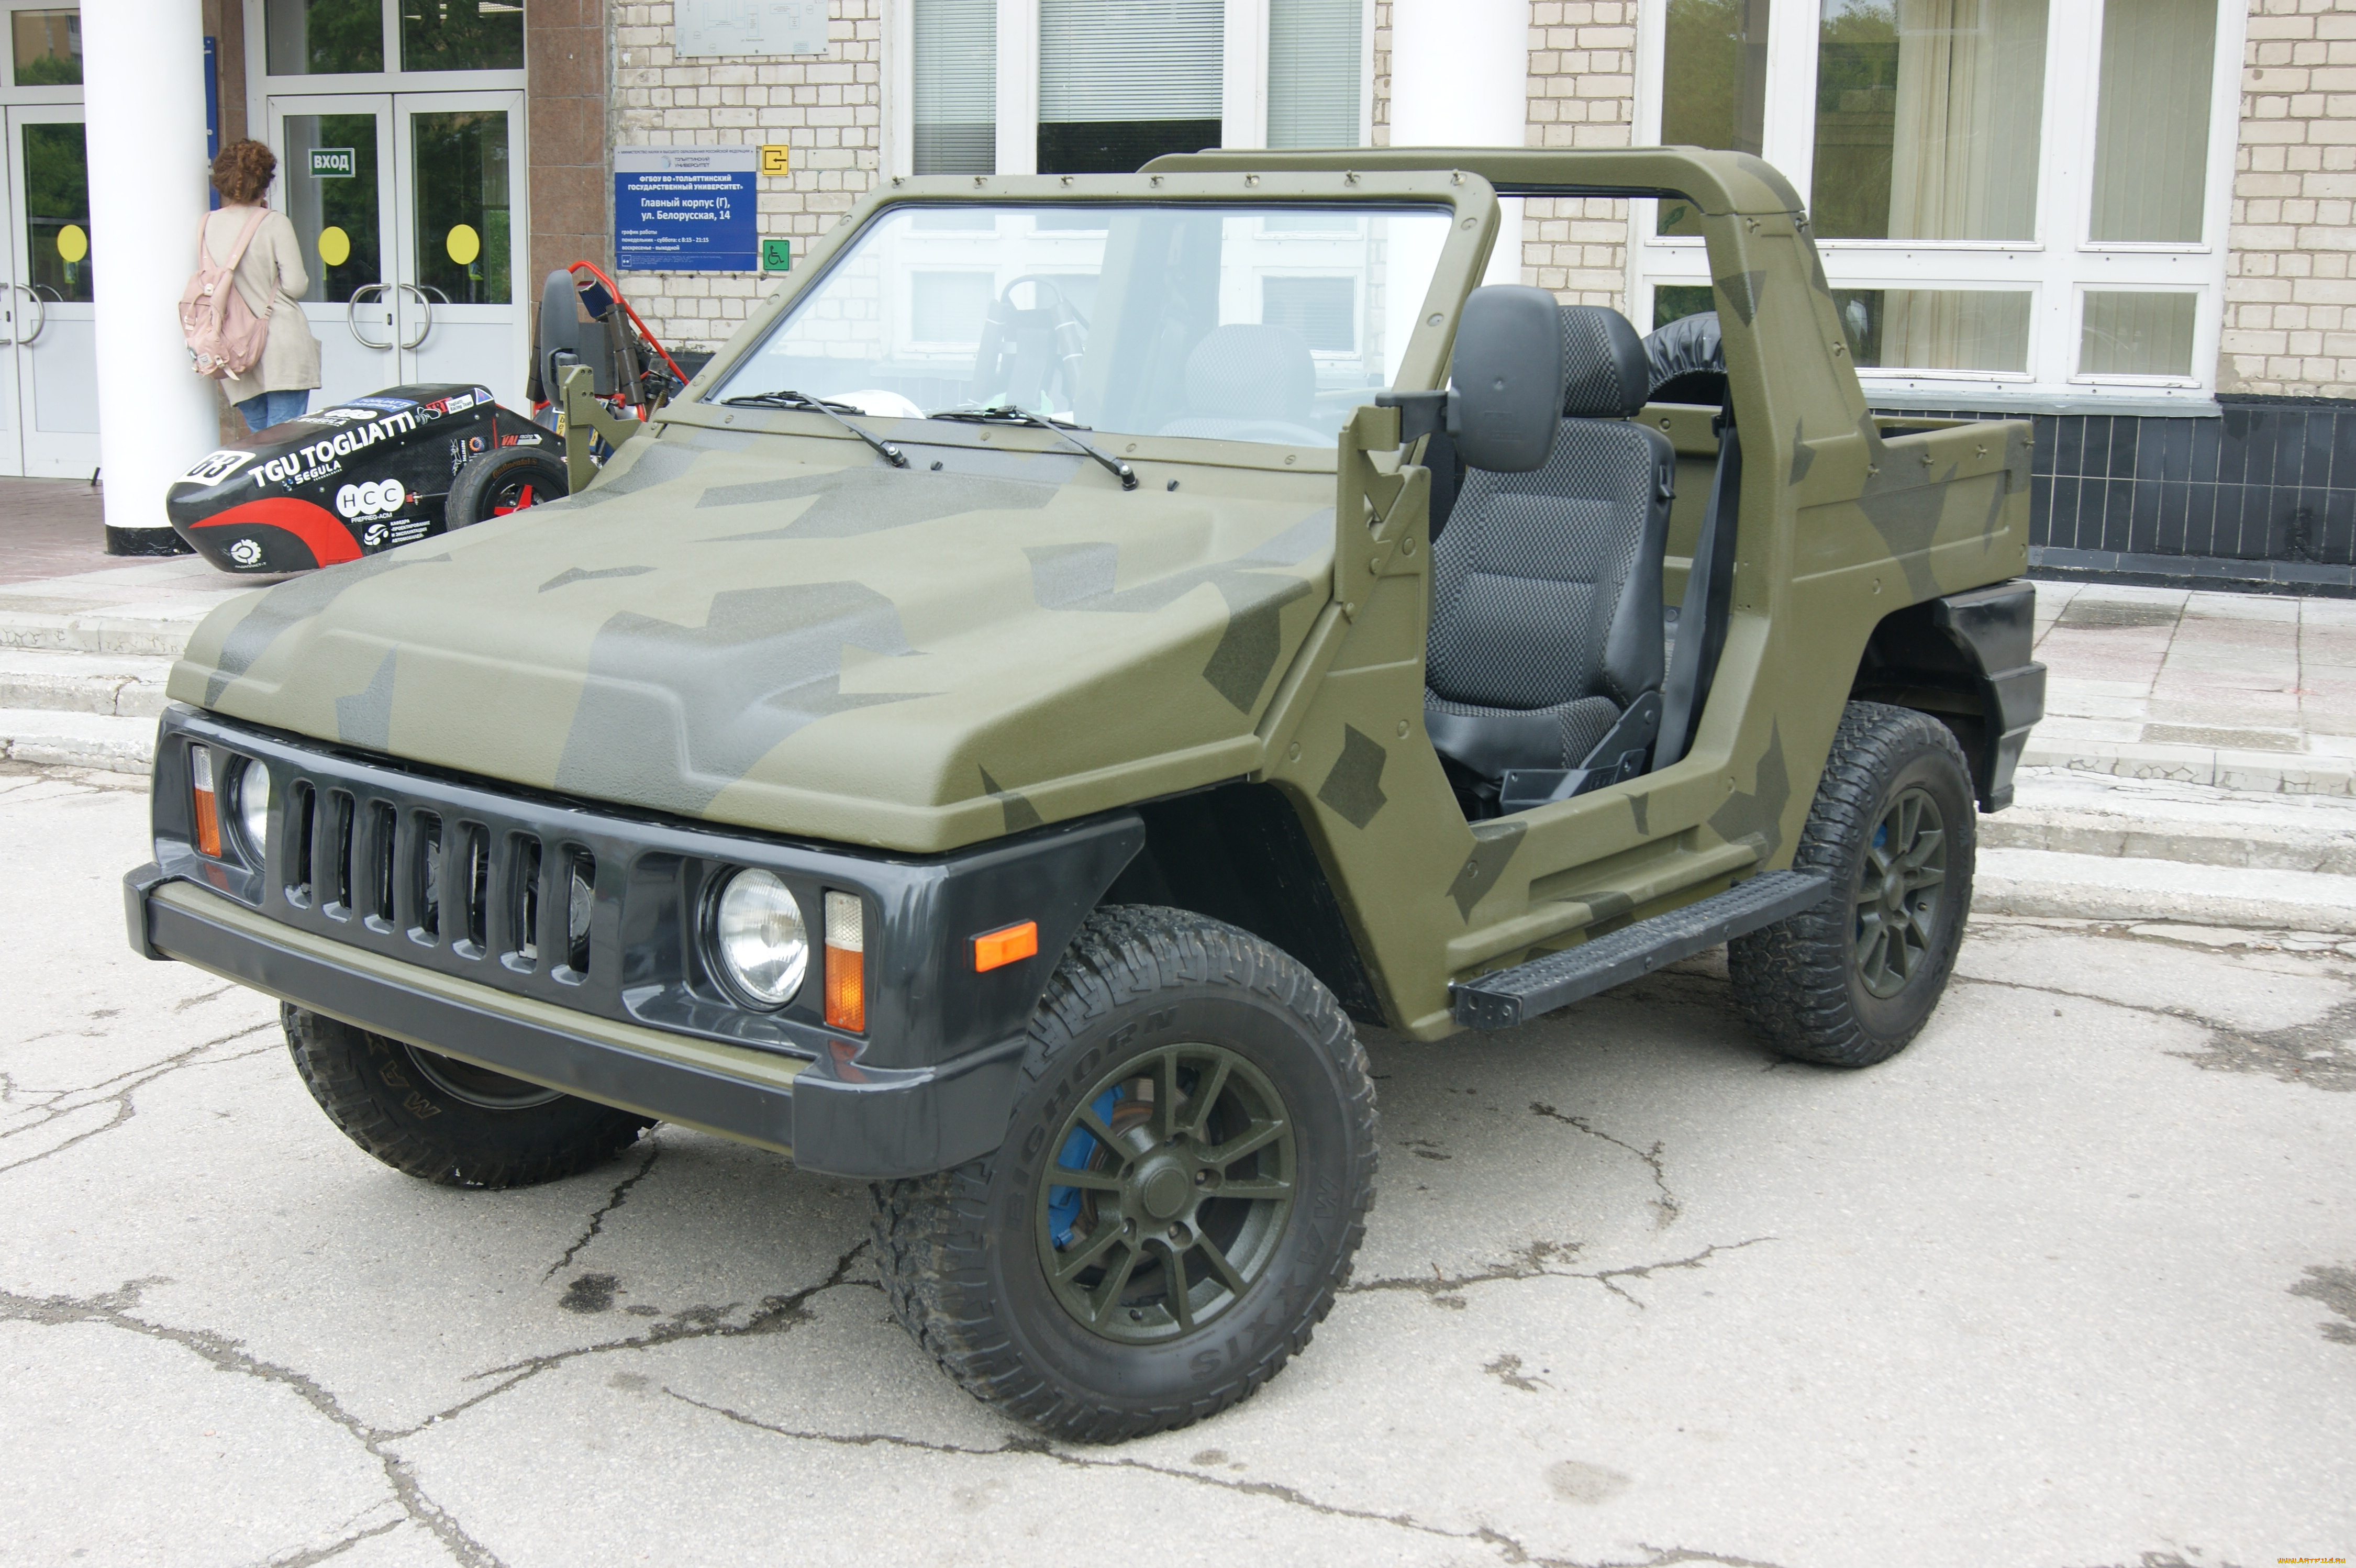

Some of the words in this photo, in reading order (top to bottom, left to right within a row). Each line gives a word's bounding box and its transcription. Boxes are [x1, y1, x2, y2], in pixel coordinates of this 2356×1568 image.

[314, 155, 349, 171] ВХОД
[641, 197, 680, 207] Главный
[682, 199, 714, 209] корпус
[716, 197, 731, 208] (Г),
[641, 213, 655, 221] ул.
[657, 210, 717, 221] Белорусская,
[719, 210, 730, 219] 14
[359, 399, 412, 407] TOGLIATTI
[248, 452, 301, 488] TGU
[300, 411, 416, 468] TOGLIATTI
[186, 454, 242, 478] 63
[294, 460, 342, 485] SEGULA
[493, 458, 530, 479] Continental
[343, 487, 397, 509] HCC
[351, 512, 393, 524] PREPREG-ACM
[1005, 1006, 1179, 1227] BIGHORN
[1188, 1175, 1339, 1381] MAXXIS
